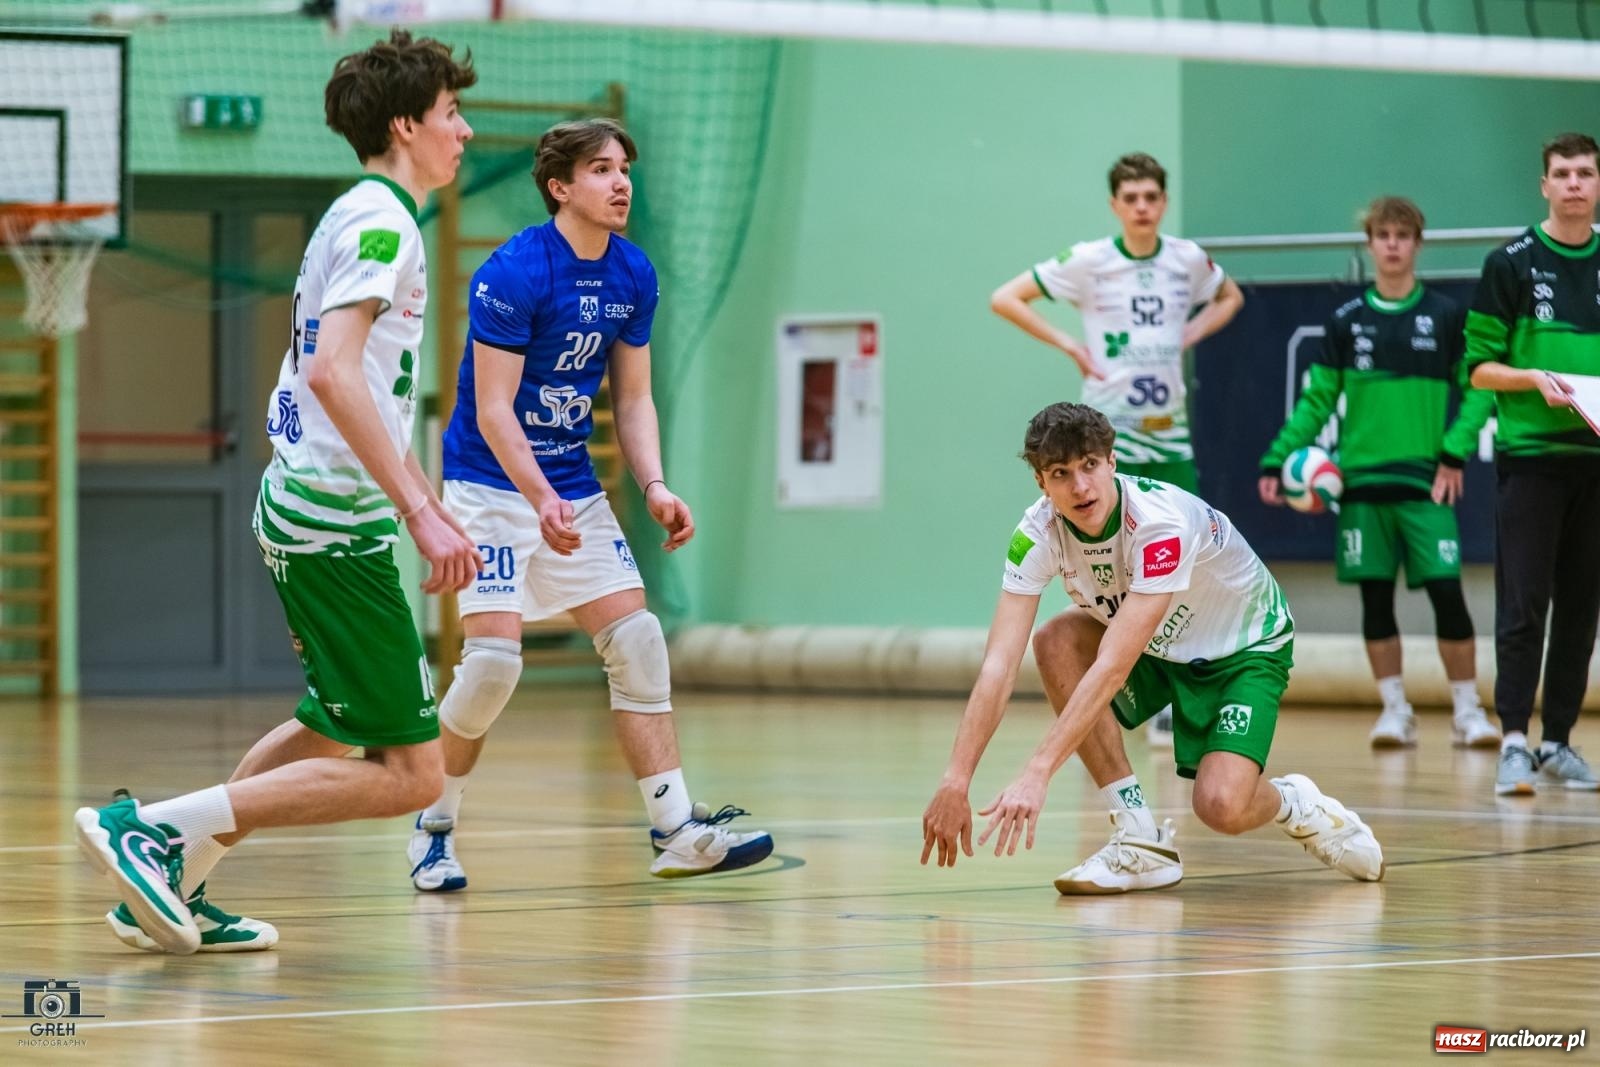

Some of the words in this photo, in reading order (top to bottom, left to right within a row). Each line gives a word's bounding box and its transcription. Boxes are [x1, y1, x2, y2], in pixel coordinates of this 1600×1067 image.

[1131, 295, 1165, 327] 52
[553, 331, 602, 372] 20
[477, 545, 515, 581] 20
[1083, 547, 1112, 556] CUTLINE
[1146, 560, 1178, 571] TAURON
[477, 585, 515, 593] CUTLINE
[1148, 604, 1189, 653] team
